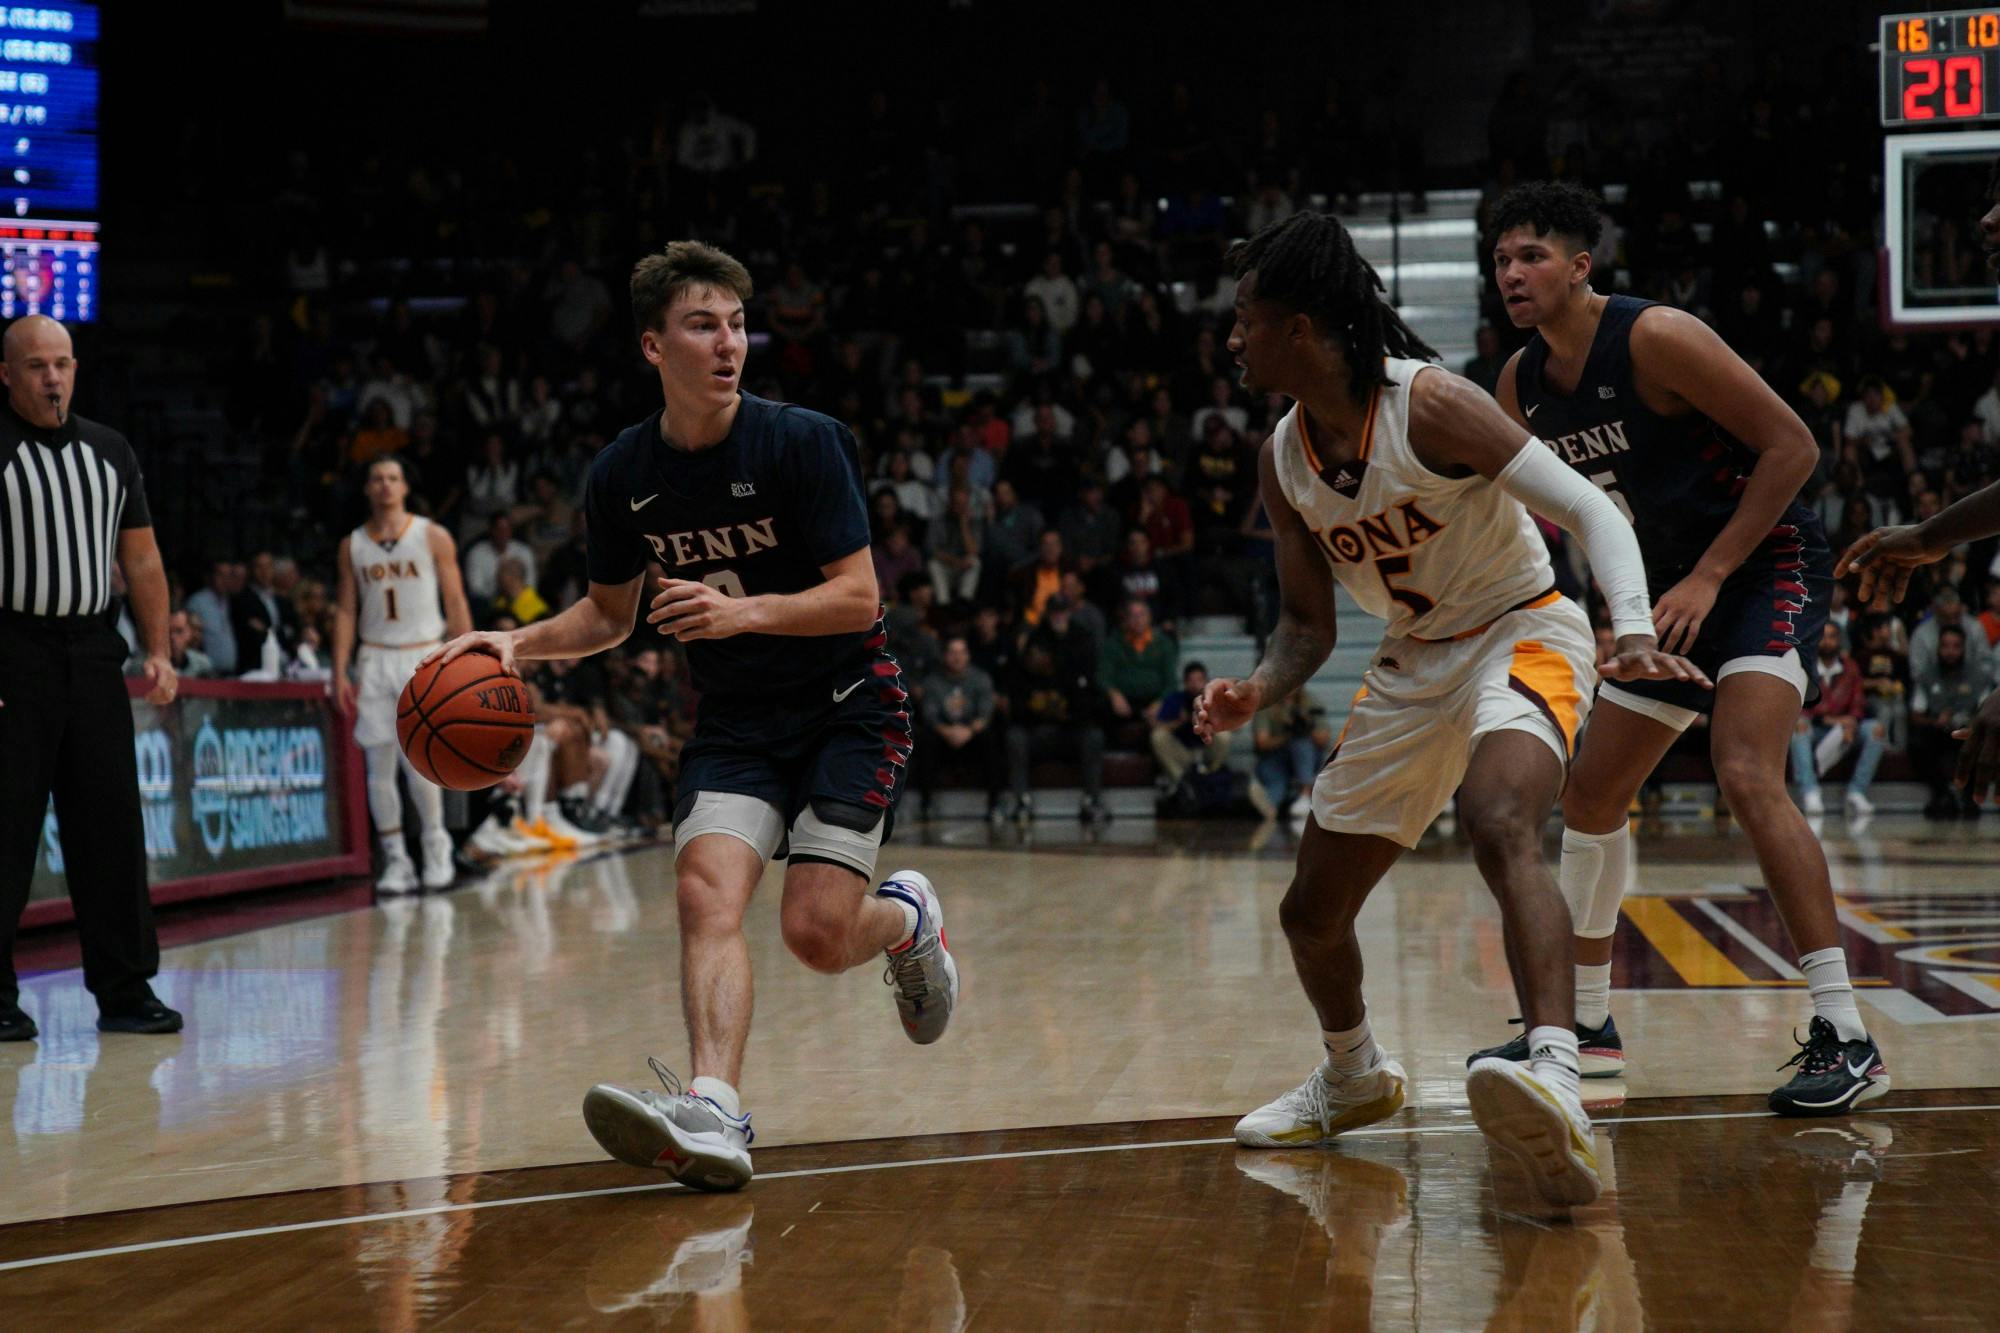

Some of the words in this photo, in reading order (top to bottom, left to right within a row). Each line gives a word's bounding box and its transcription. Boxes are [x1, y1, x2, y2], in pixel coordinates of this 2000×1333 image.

[1903, 56, 1982, 120] 20
[643, 516, 780, 567] PENN
[1308, 497, 1446, 564] IONA
[361, 561, 419, 585] IONA
[384, 586, 399, 621] 1
[1374, 554, 1433, 617] 5
[476, 685, 522, 714] ROCK
[223, 726, 325, 794] RIDGEWOOD
[227, 794, 289, 850] SAVINGS
[287, 789, 328, 844] BANK
